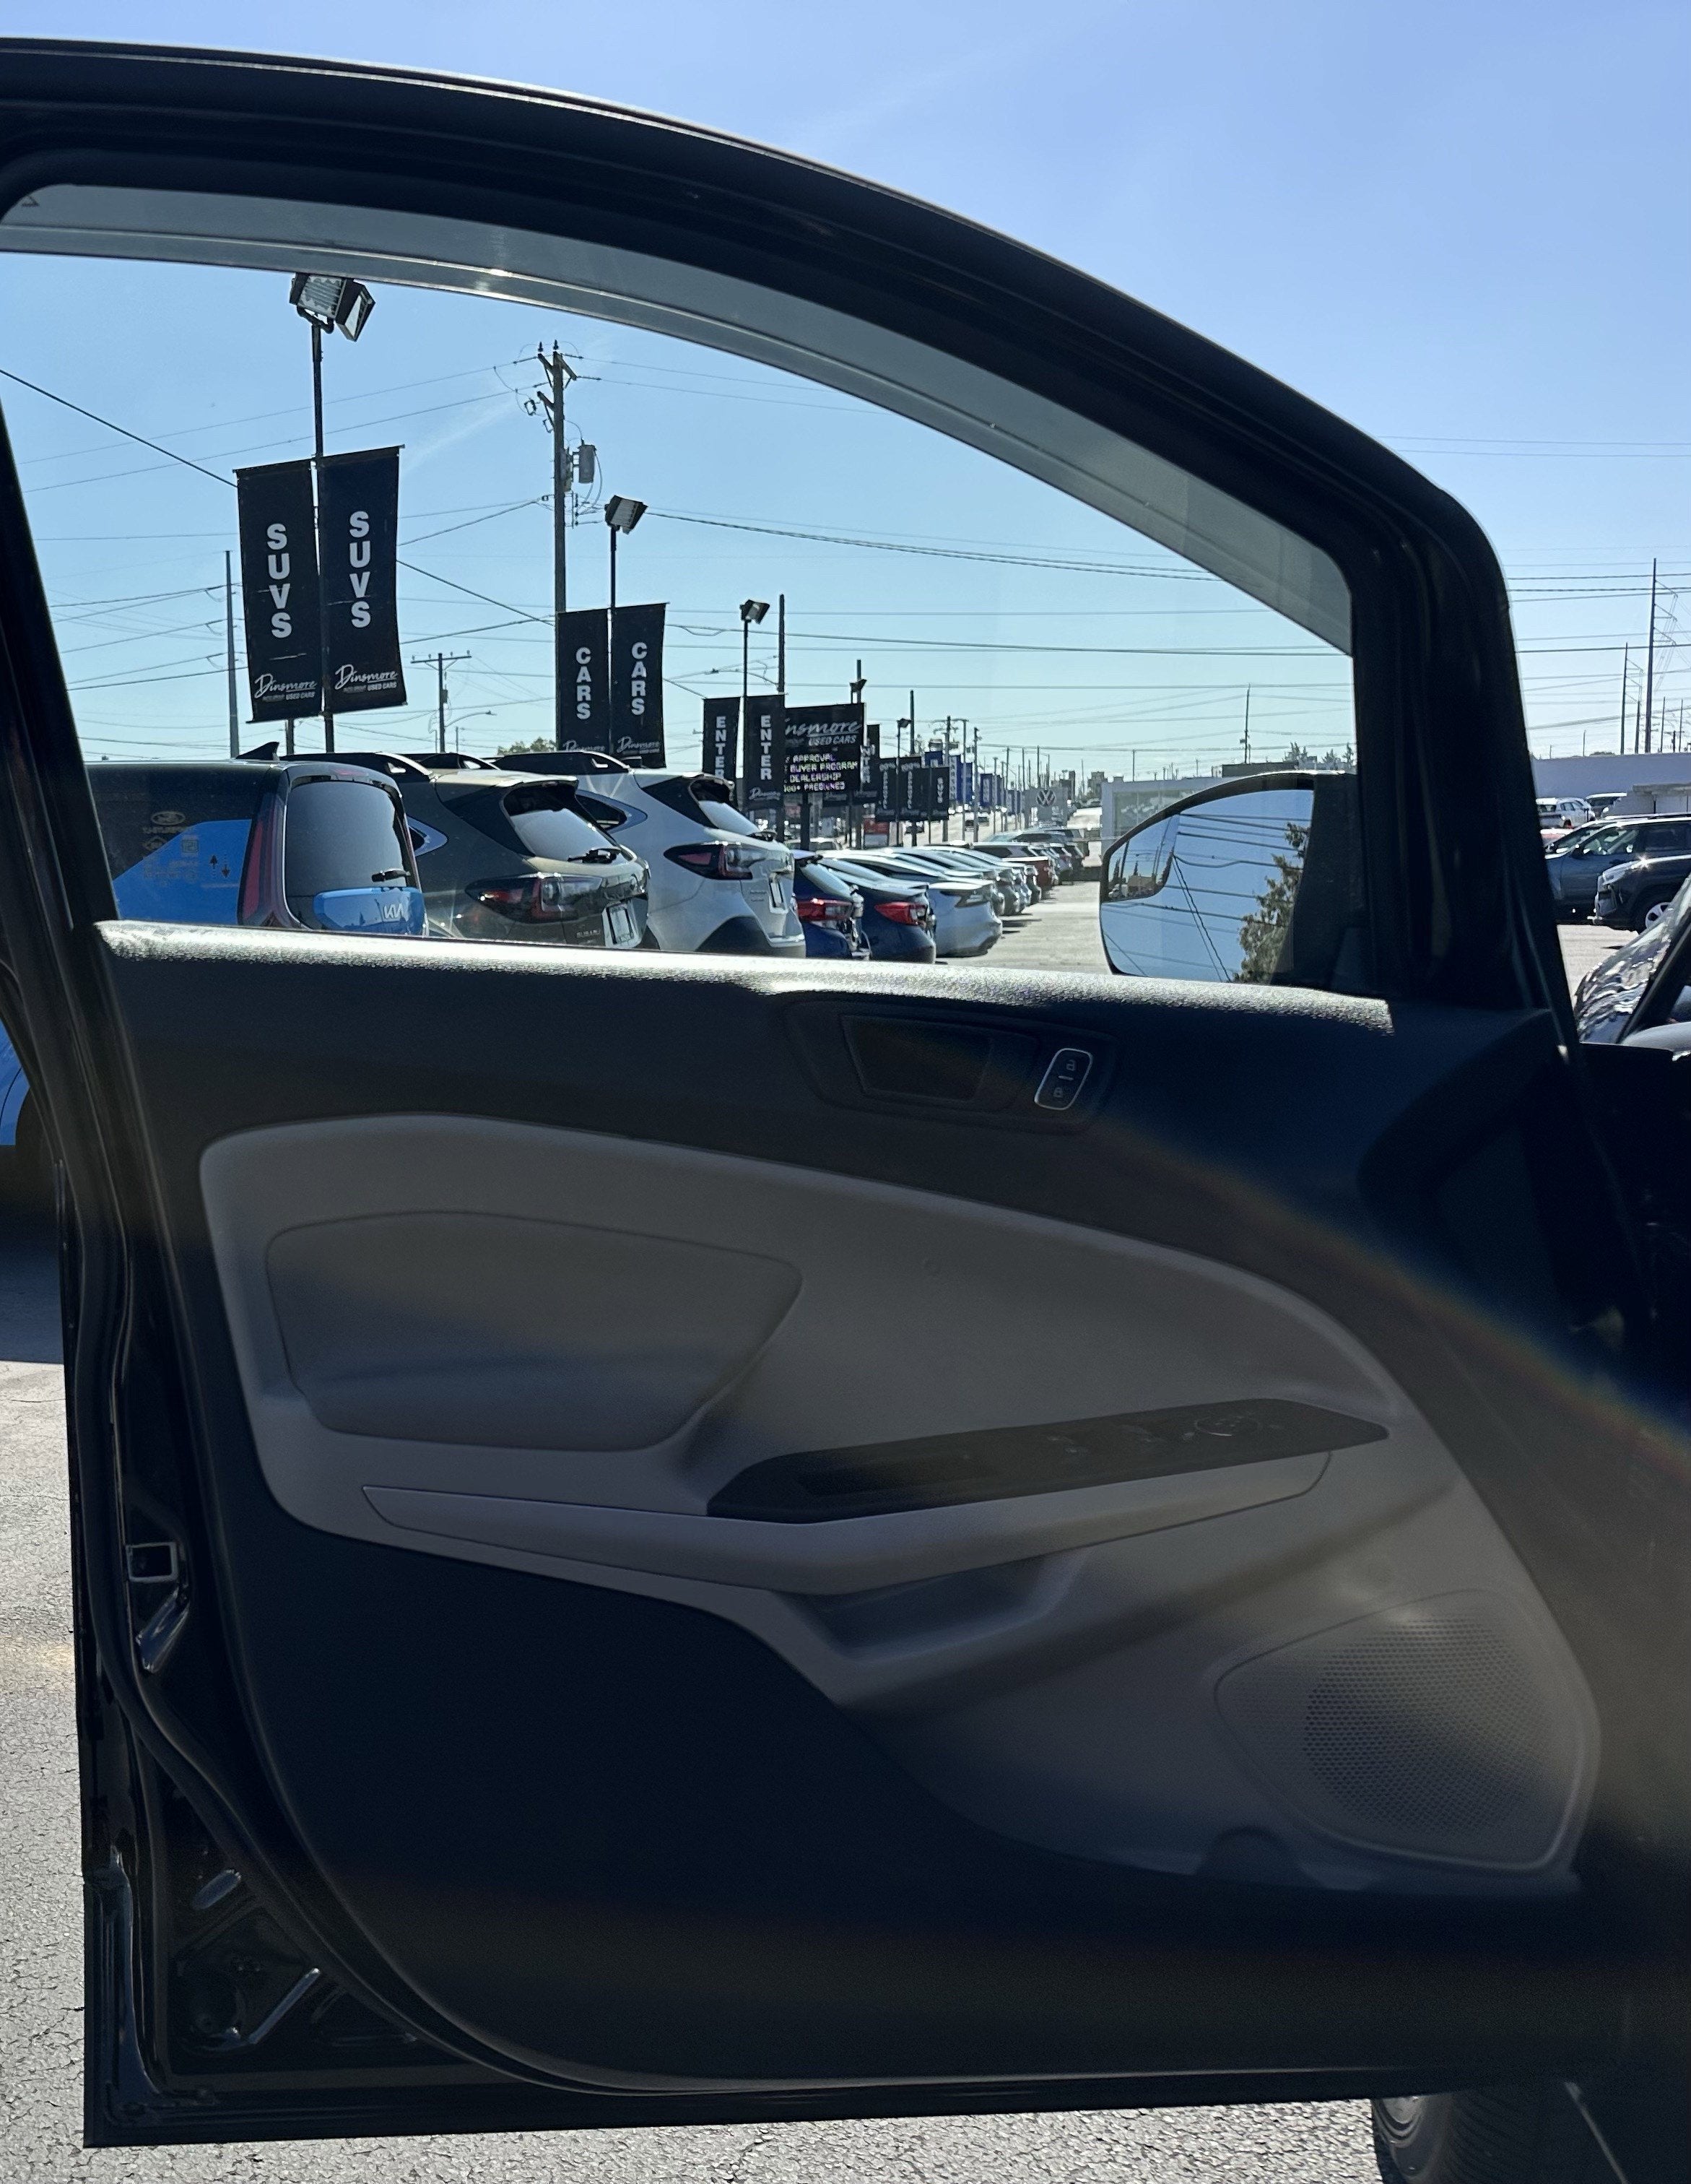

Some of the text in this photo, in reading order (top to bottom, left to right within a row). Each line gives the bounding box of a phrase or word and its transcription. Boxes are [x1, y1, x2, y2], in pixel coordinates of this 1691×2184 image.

[266, 523, 292, 638] SUVS
[349, 511, 371, 628] SUVS
[254, 673, 318, 698] Dinsmore
[334, 664, 398, 690] Dinsmore
[575, 646, 591, 720] CARS
[631, 641, 648, 716] CARS
[715, 716, 726, 779] ENTER
[760, 714, 773, 781] ENTER
[785, 718, 863, 737] nsmore
[809, 737, 833, 747] USED
[833, 735, 857, 745] CARS
